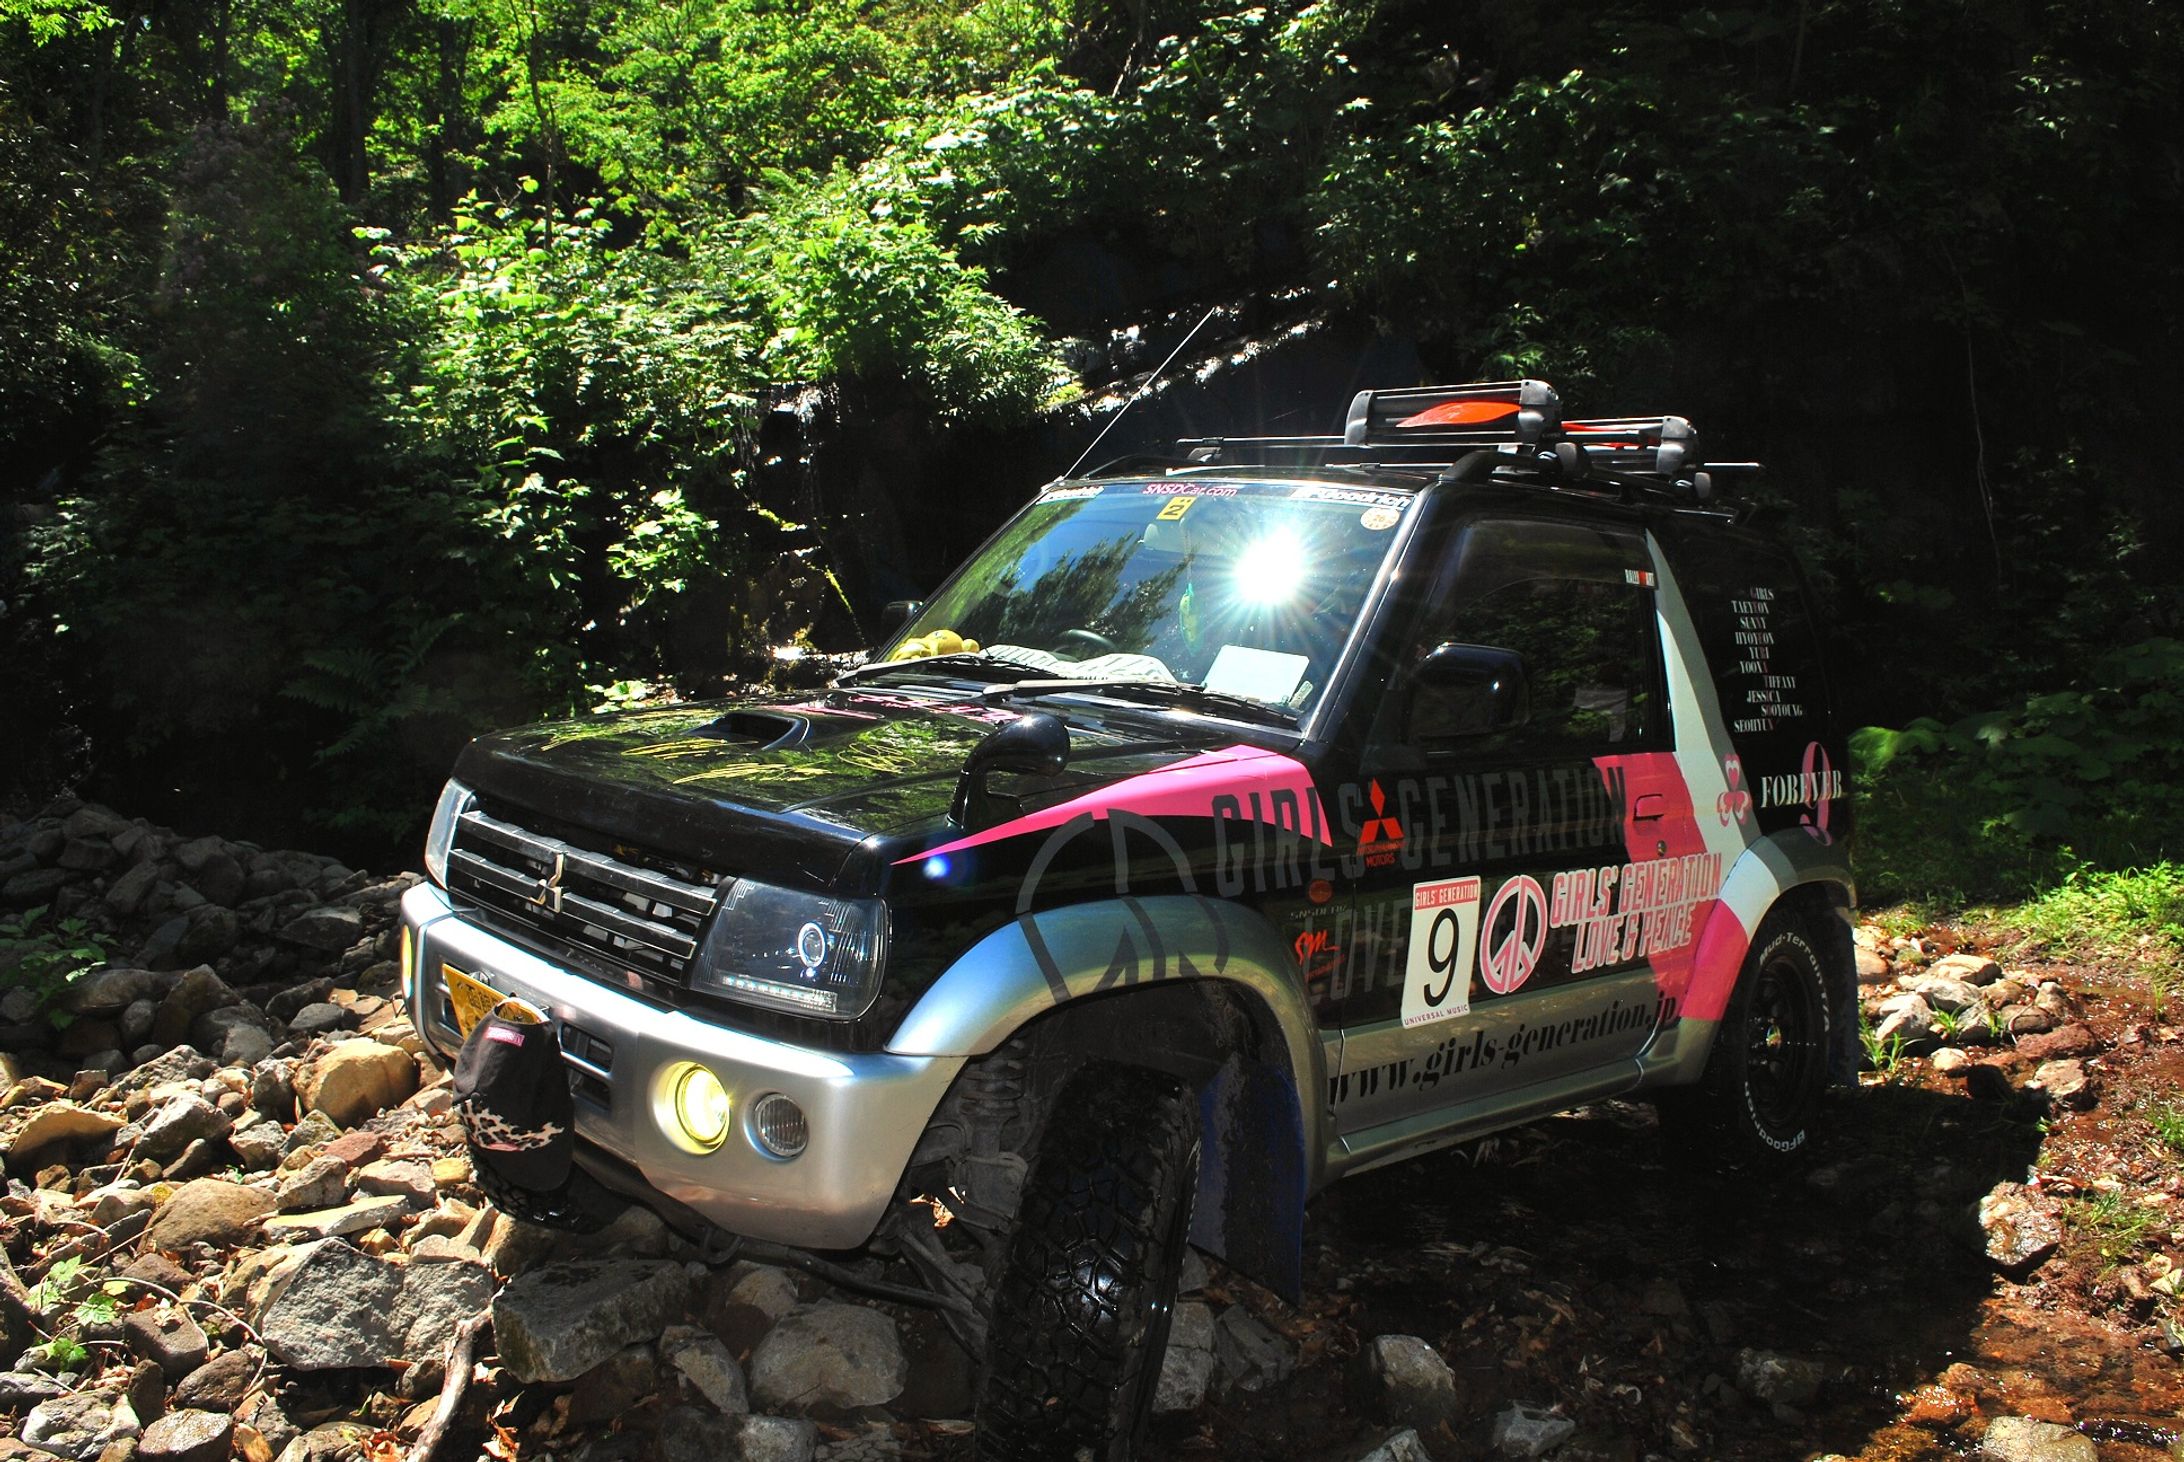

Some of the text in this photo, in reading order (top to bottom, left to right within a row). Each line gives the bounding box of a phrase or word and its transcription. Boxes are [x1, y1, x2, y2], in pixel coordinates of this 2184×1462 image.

[1143, 484, 1238, 498] SNSDCar.com
[1747, 690, 1780, 703] JESSICA
[1760, 770, 1842, 808] FOREVER
[1398, 767, 1626, 870] GENERATION
[1366, 853, 1396, 868] MOTORS
[1415, 883, 1478, 907] GIRLS' GENERATION
[1549, 865, 1619, 929] GIRLS'
[1619, 852, 1722, 915] GENERATION
[1571, 914, 1624, 974] LOVE
[1621, 912, 1639, 961] &
[1638, 902, 1696, 957] PEACE
[1423, 908, 1459, 1007] 9
[1404, 1004, 1468, 1025] UNIVERSAL MUSIC
[1328, 990, 1677, 1105] www.girls-generation.jp
